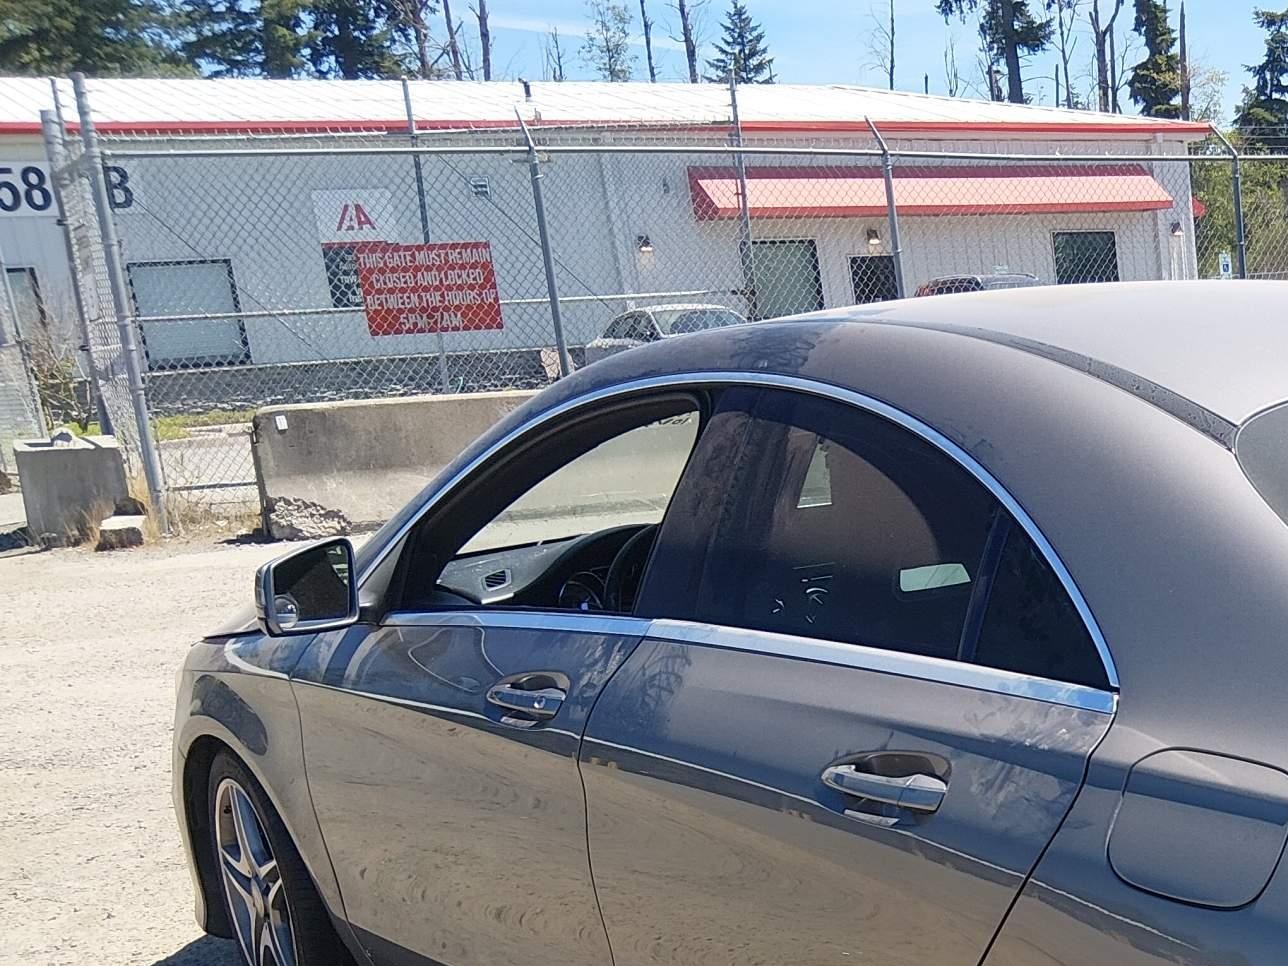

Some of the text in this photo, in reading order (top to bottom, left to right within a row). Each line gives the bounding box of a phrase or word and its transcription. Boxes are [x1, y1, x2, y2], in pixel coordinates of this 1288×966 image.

[358, 253, 386, 268] THIS
[386, 251, 413, 267] GATE
[415, 250, 446, 266] MUST
[447, 247, 492, 264] REMAIN
[373, 270, 484, 288] CLOSED AND LOCKED
[367, 293, 420, 310] BETWEEN
[421, 292, 442, 308] THE
[444, 291, 479, 306] HOURS
[483, 289, 498, 304] OF
